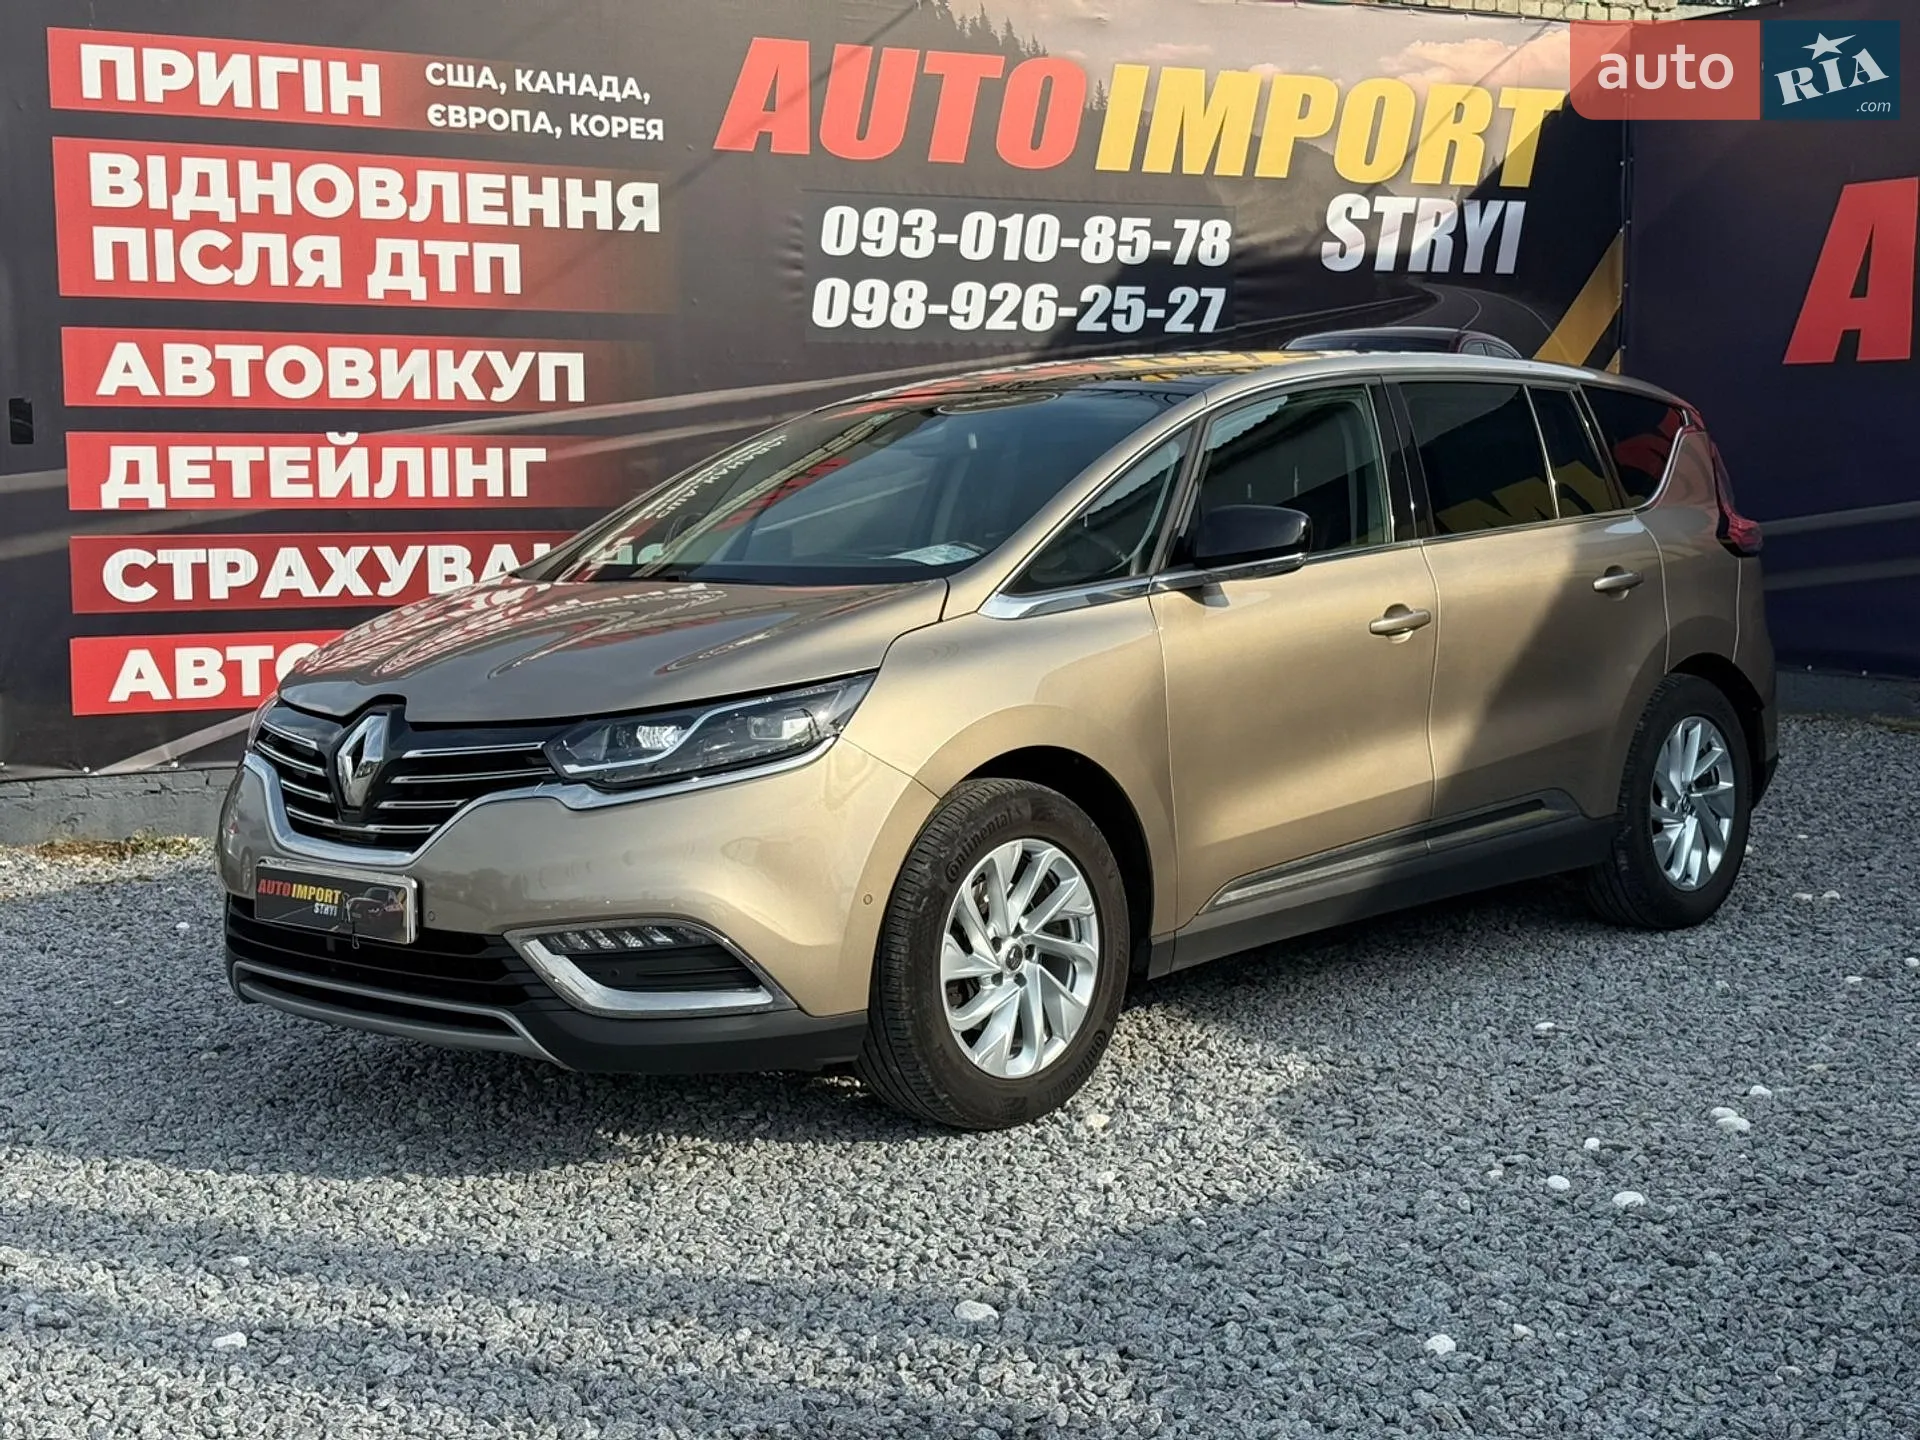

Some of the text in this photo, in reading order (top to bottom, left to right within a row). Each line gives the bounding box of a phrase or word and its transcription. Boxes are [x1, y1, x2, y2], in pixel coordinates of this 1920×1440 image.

[80, 43, 381, 117] ПРИГІН
[425, 62, 651, 105] США, КАНАДА,
[427, 104, 664, 142] ЄВРОПА, КОРЕЯ
[89, 152, 660, 233] ВІДНОВЛЕННЯ
[92, 226, 522, 301] ПІСЛЯ ДТП
[820, 205, 1232, 266] 093-010-85-78
[1320, 193, 1526, 275] STRYI
[811, 277, 1227, 333] 098-926-25-27
[95, 342, 585, 403] АВТОВИКУП
[100, 431, 547, 509] ДЕТЕЙЛІНГ
[944, 806, 1014, 883] Continental
[257, 878, 342, 905] AUTOIMPORT
[313, 902, 338, 917] STRYI
